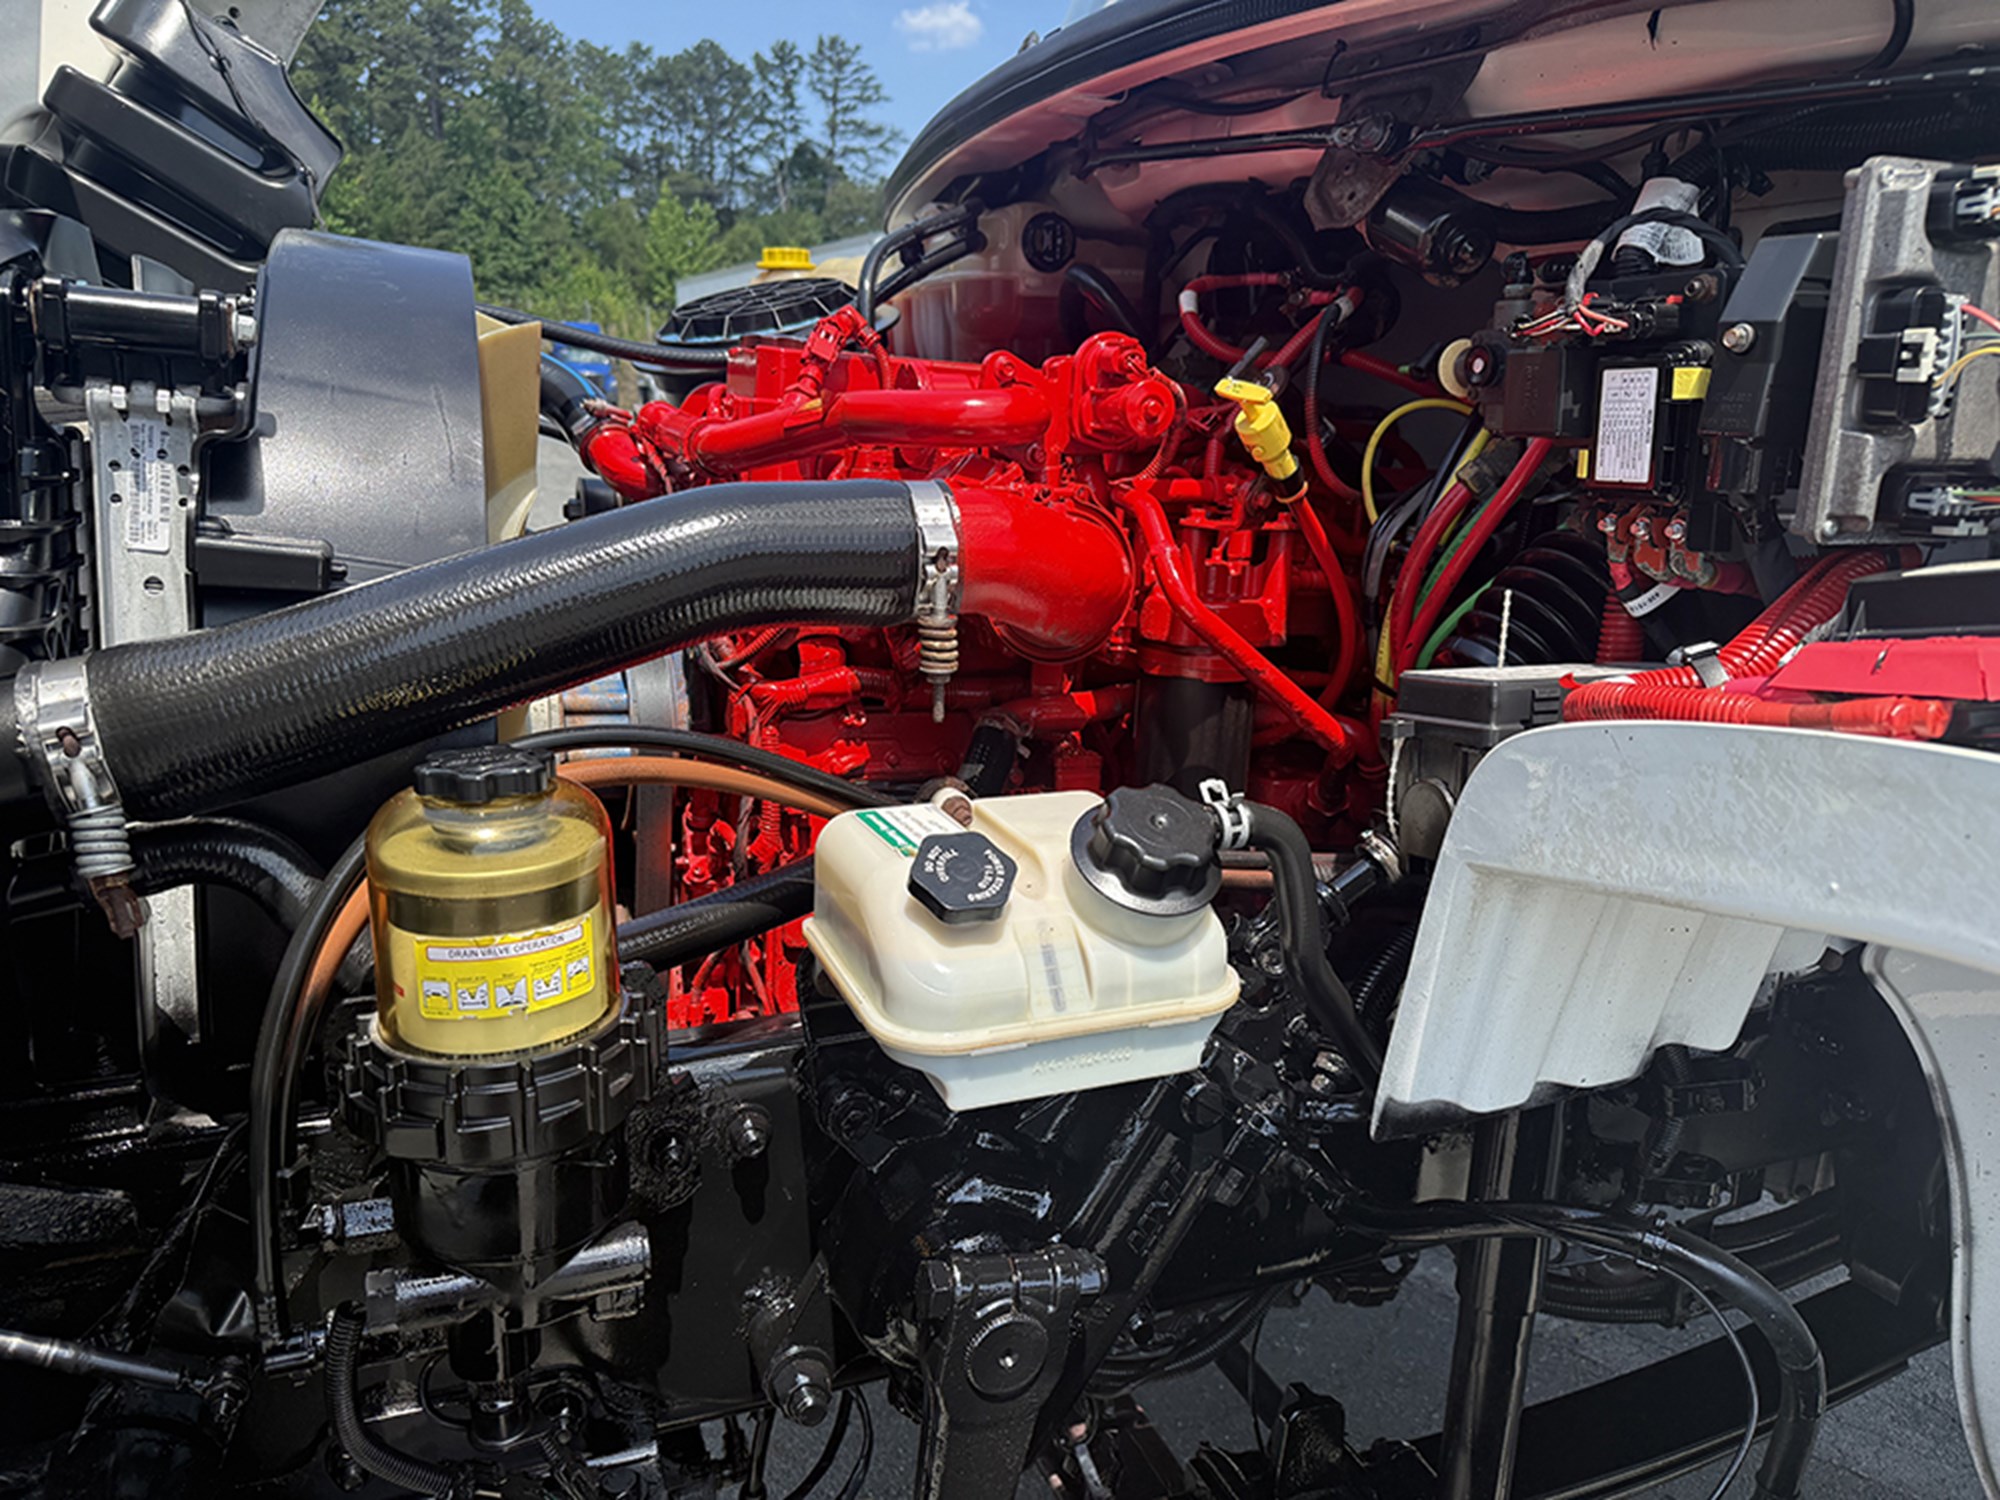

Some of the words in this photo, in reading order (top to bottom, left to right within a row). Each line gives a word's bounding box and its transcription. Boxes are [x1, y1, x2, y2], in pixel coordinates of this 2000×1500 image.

[927, 845, 942, 861] NOT
[984, 849, 1004, 875] POWER
[924, 860, 934, 872] DO
[977, 864, 994, 889] FLUID
[967, 877, 1005, 902] STEERING
[447, 949, 480, 959] DRAIN
[480, 946, 511, 957] VALVE
[513, 935, 565, 953] OPERATION
